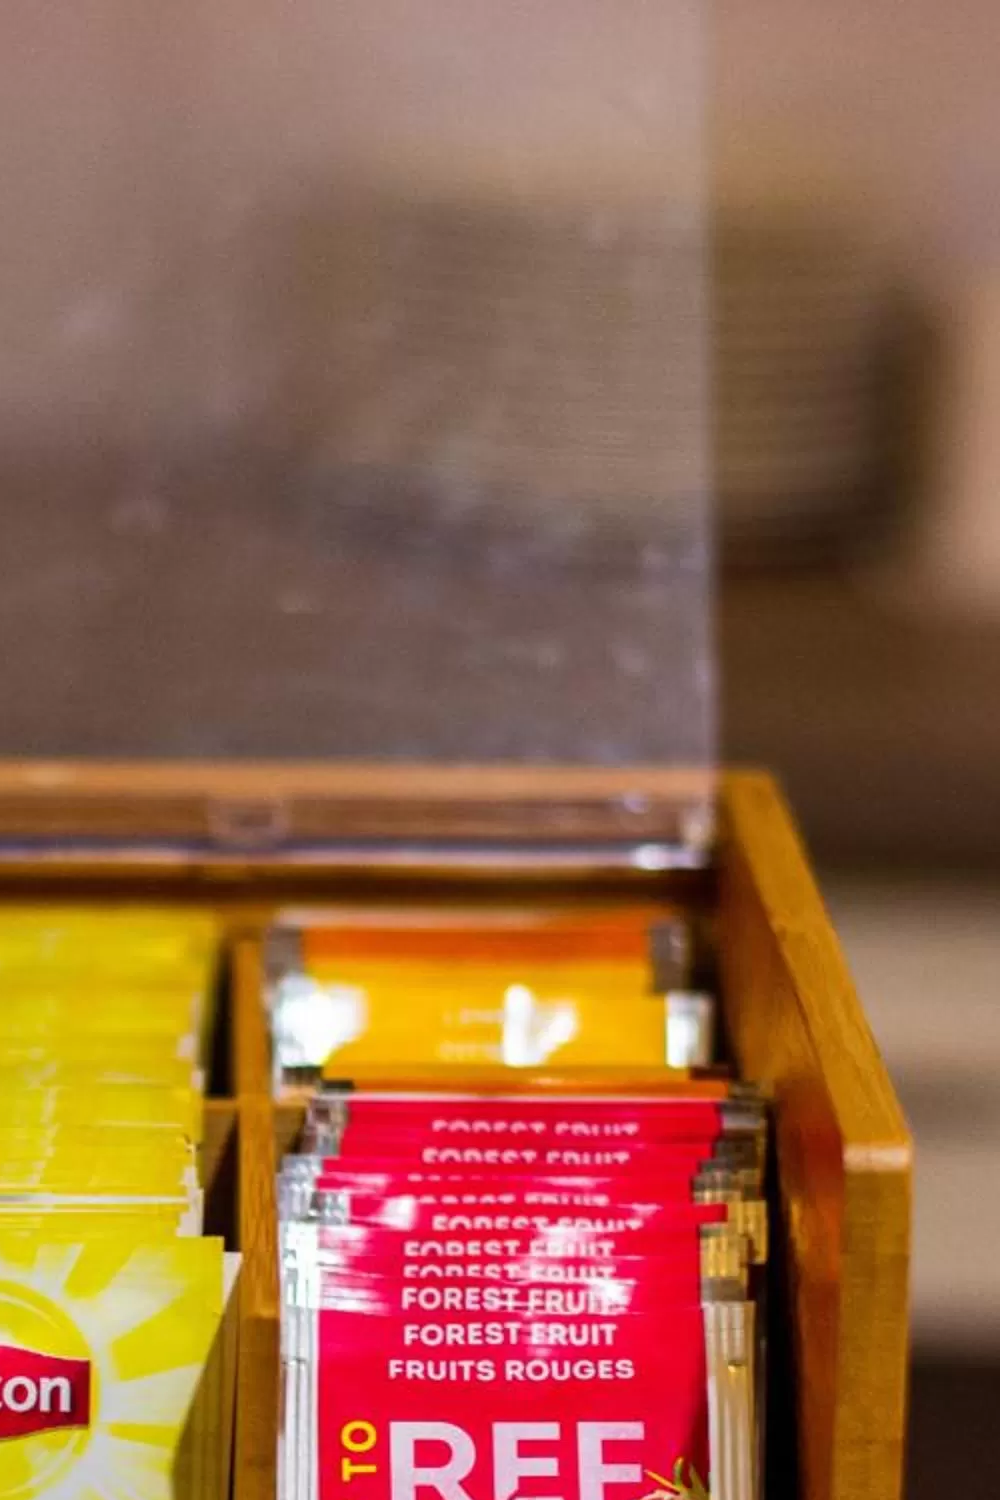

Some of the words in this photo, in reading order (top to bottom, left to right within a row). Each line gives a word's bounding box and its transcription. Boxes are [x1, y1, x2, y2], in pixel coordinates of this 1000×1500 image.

[401, 1286, 521, 1313] FOREST
[403, 1322, 523, 1346] FOREST
[530, 1322, 617, 1347] FRUIT
[388, 1360, 496, 1381] FRUITS
[504, 1359, 636, 1381] ROUGES
[340, 1420, 378, 1482] TO
